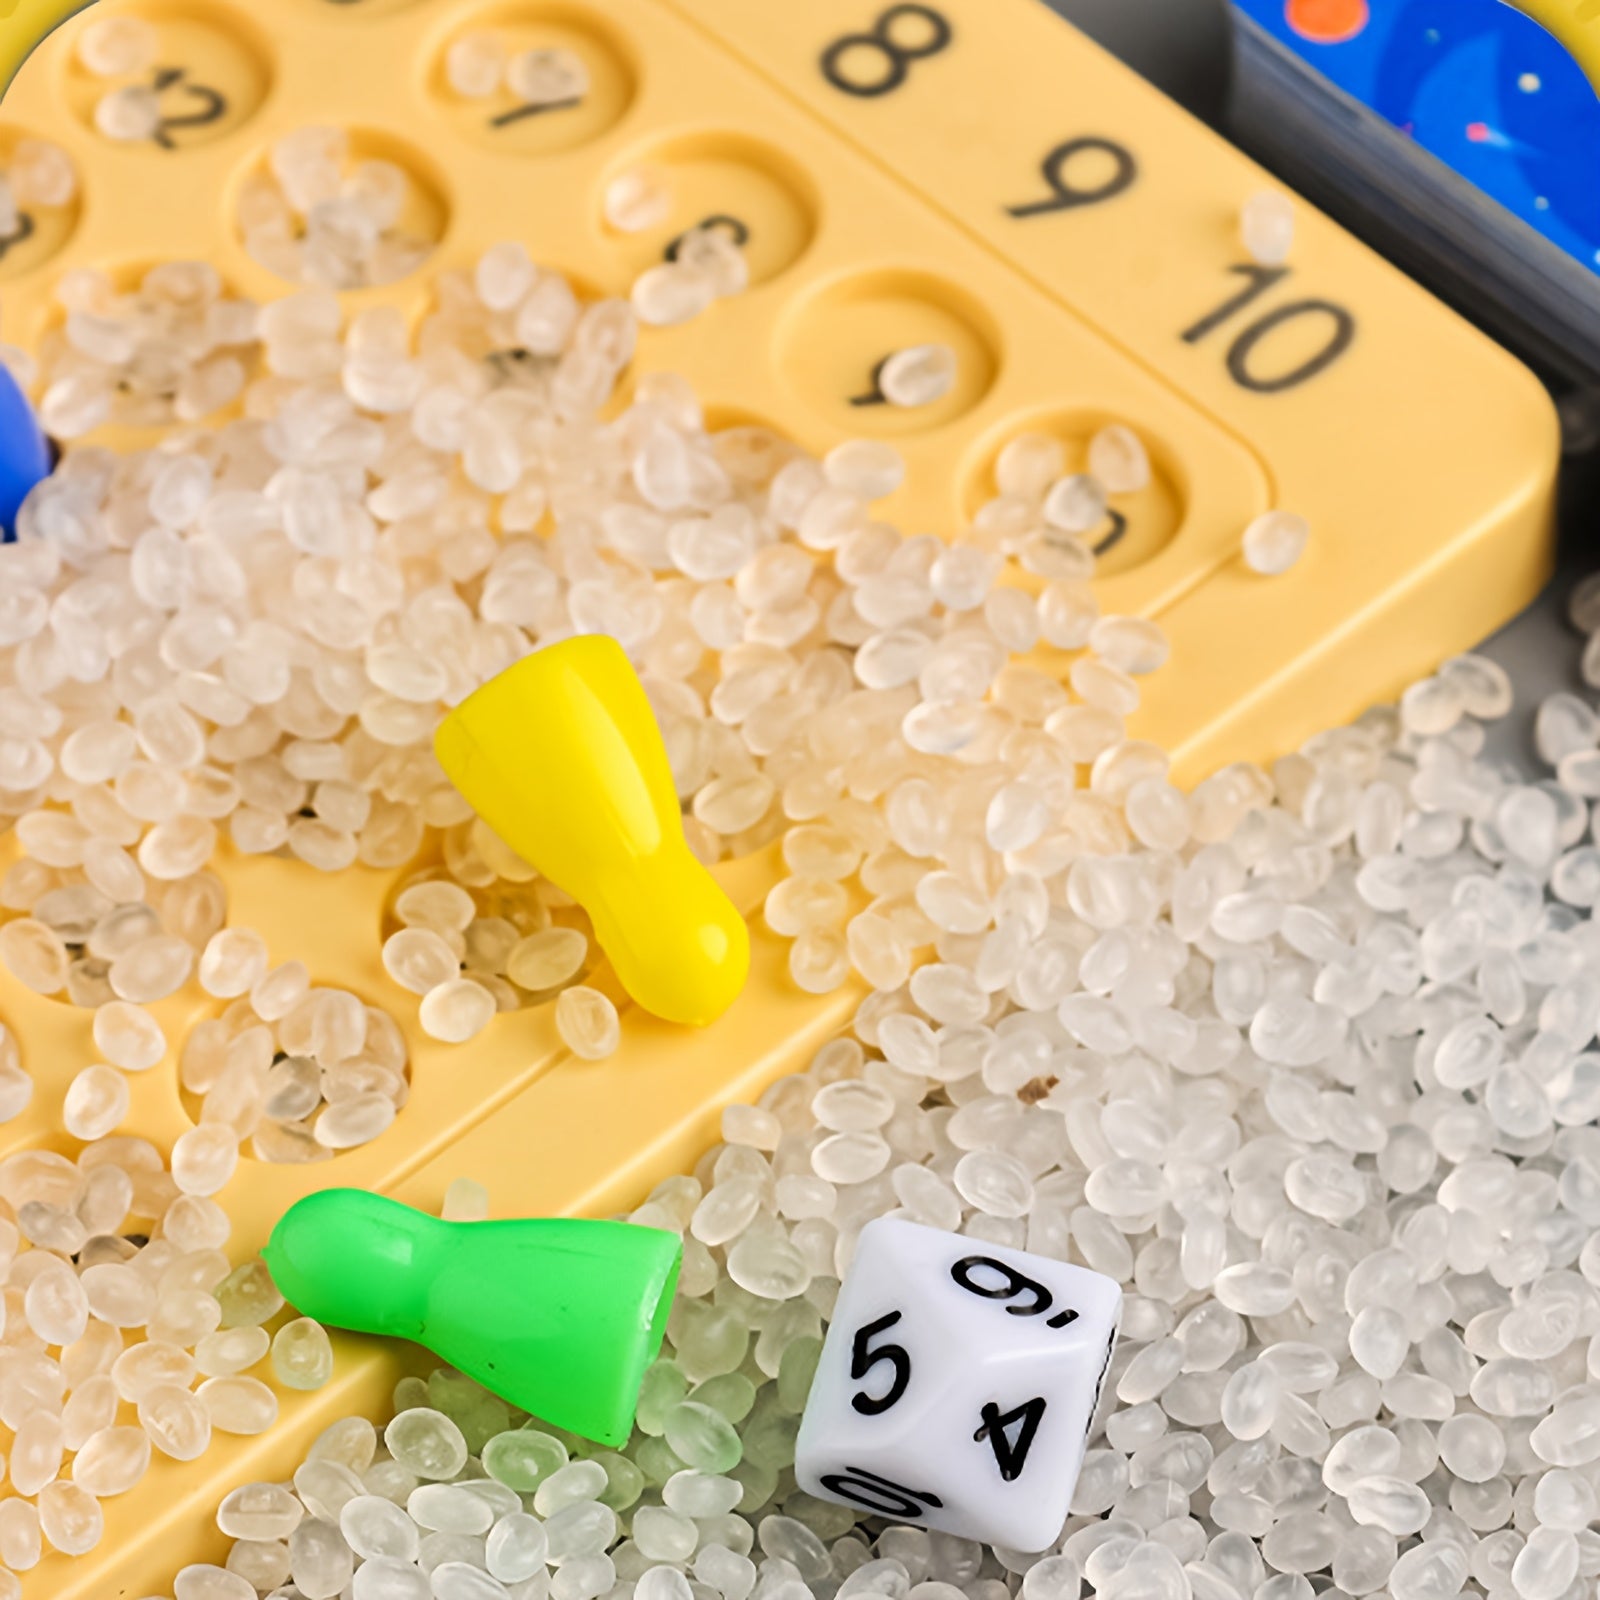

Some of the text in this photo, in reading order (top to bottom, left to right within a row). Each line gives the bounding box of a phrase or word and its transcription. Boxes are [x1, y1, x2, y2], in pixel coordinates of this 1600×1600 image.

[820, 3, 952, 98] 8
[1003, 136, 1138, 218] 9
[1180, 263, 1357, 395] 10
[850, 1310, 910, 1416] 5
[972, 1396, 1047, 1482] 4
